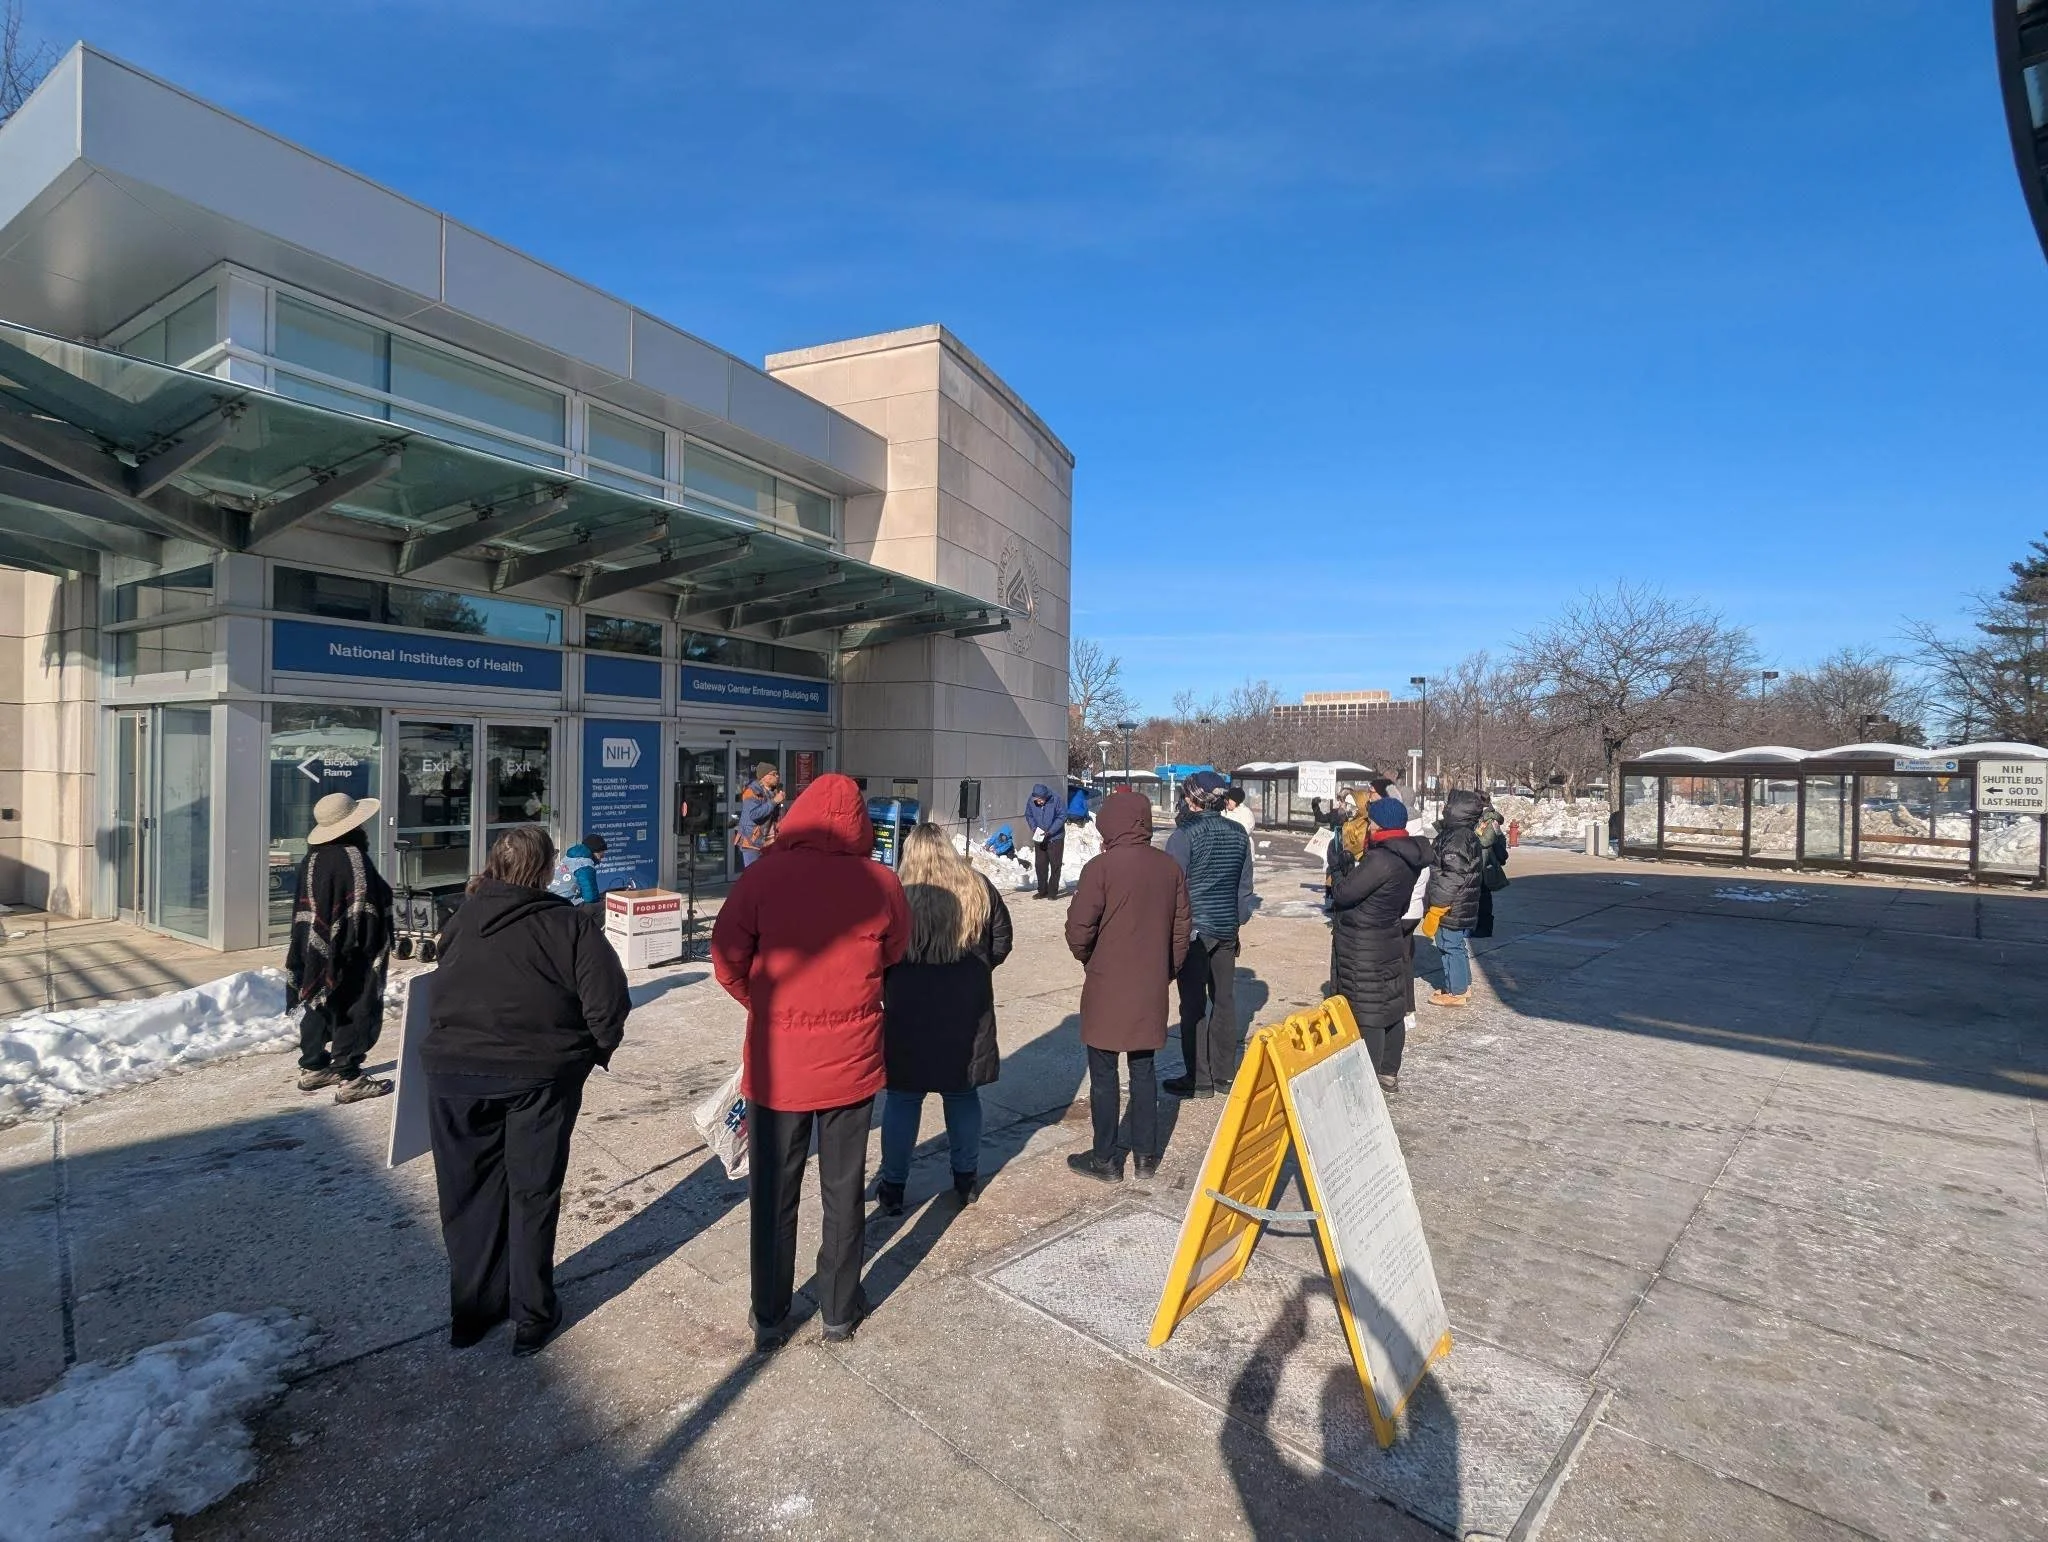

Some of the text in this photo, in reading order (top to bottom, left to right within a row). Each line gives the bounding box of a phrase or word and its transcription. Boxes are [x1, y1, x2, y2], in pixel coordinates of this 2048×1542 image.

[329, 642, 524, 673] National Institutes of Health
[693, 680, 820, 703] Gateway Center Entrance (Building 66)
[606, 746, 630, 760] NIH
[324, 758, 358, 768] Bicycle
[422, 759, 450, 772] Exit
[506, 760, 531, 773] Exit
[324, 769, 352, 777] Ramp
[1300, 777, 1336, 794] RESIST
[1982, 776, 2021, 784] SHUTTLE
[2005, 798, 2043, 807] SHELTER
